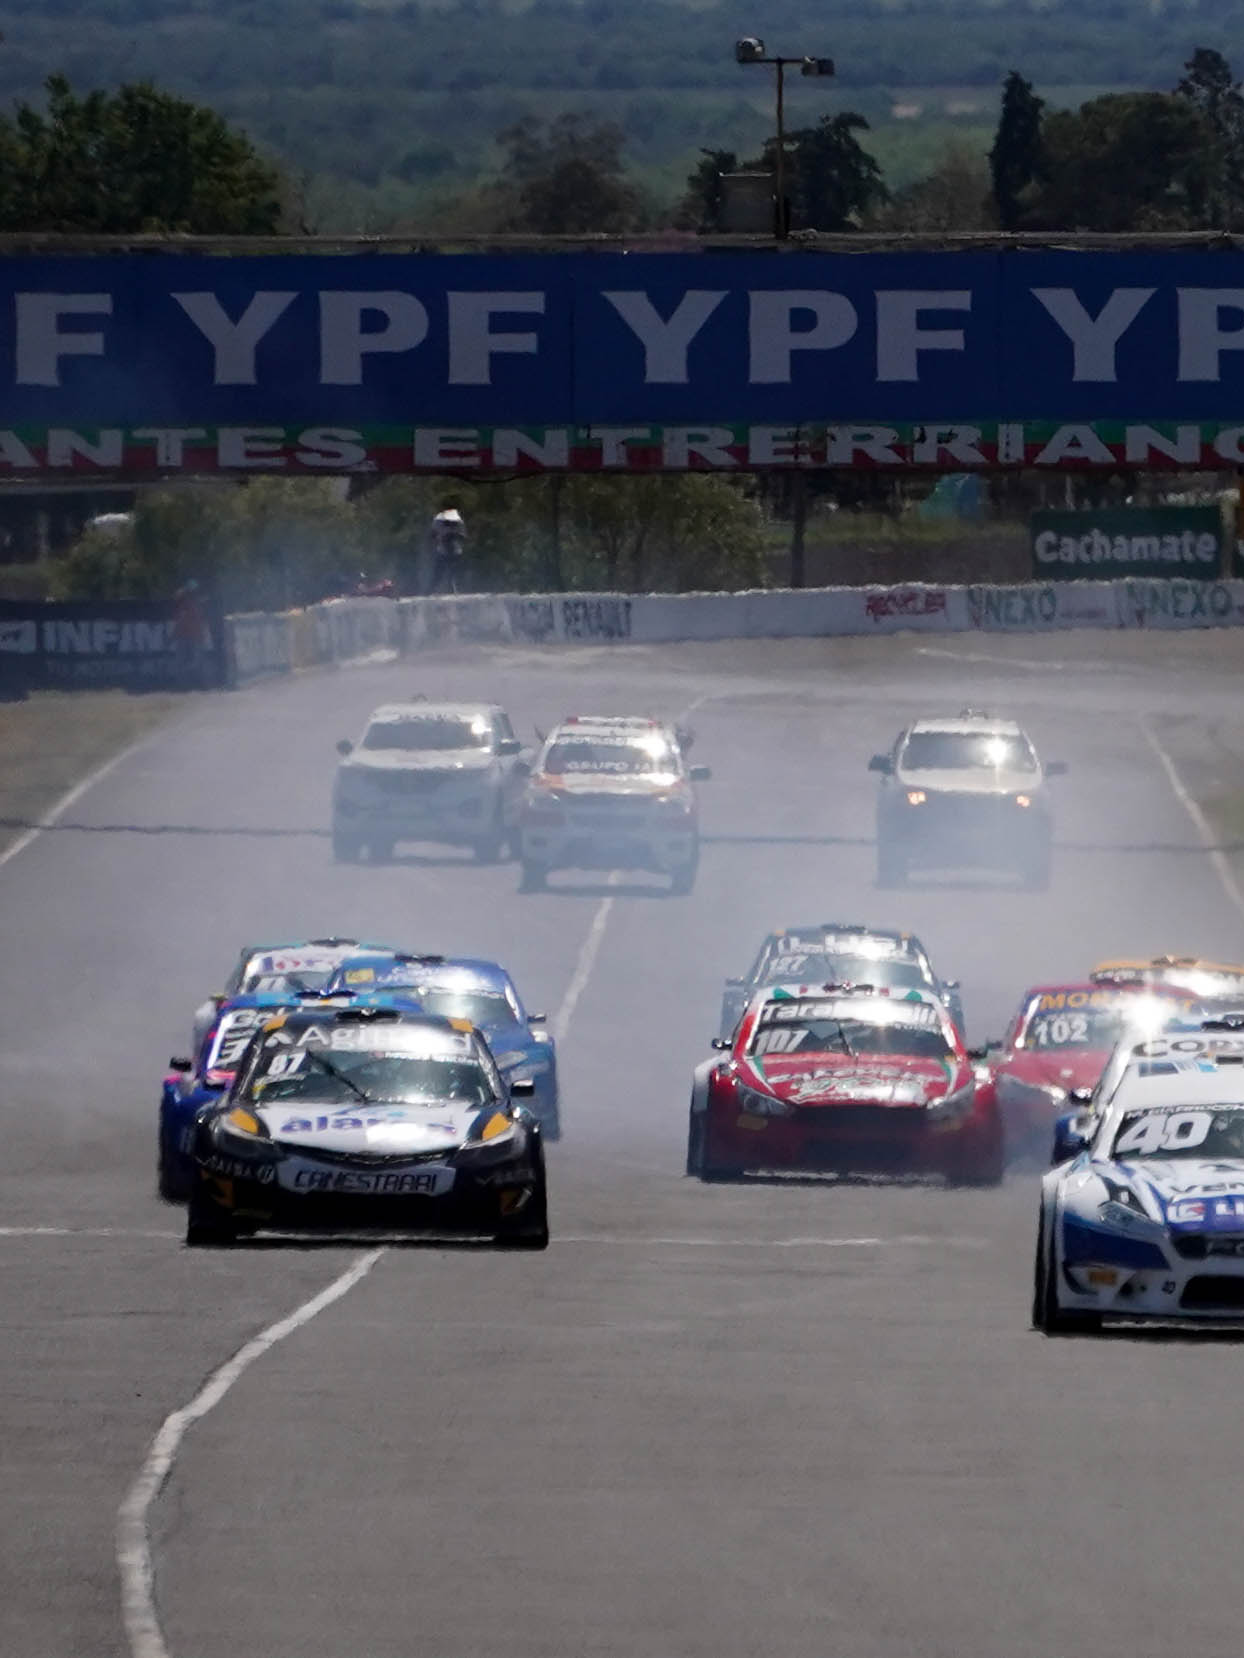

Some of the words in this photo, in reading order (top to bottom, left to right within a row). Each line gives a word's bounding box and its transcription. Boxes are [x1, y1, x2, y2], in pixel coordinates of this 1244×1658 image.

[169, 290, 546, 386] YPF
[601, 288, 972, 384] YPF
[1034, 528, 1217, 564] Cachamate
[755, 1029, 810, 1056] 107
[1035, 1019, 1088, 1045] 102
[267, 1051, 307, 1076] 87
[1114, 1111, 1214, 1155] 40
